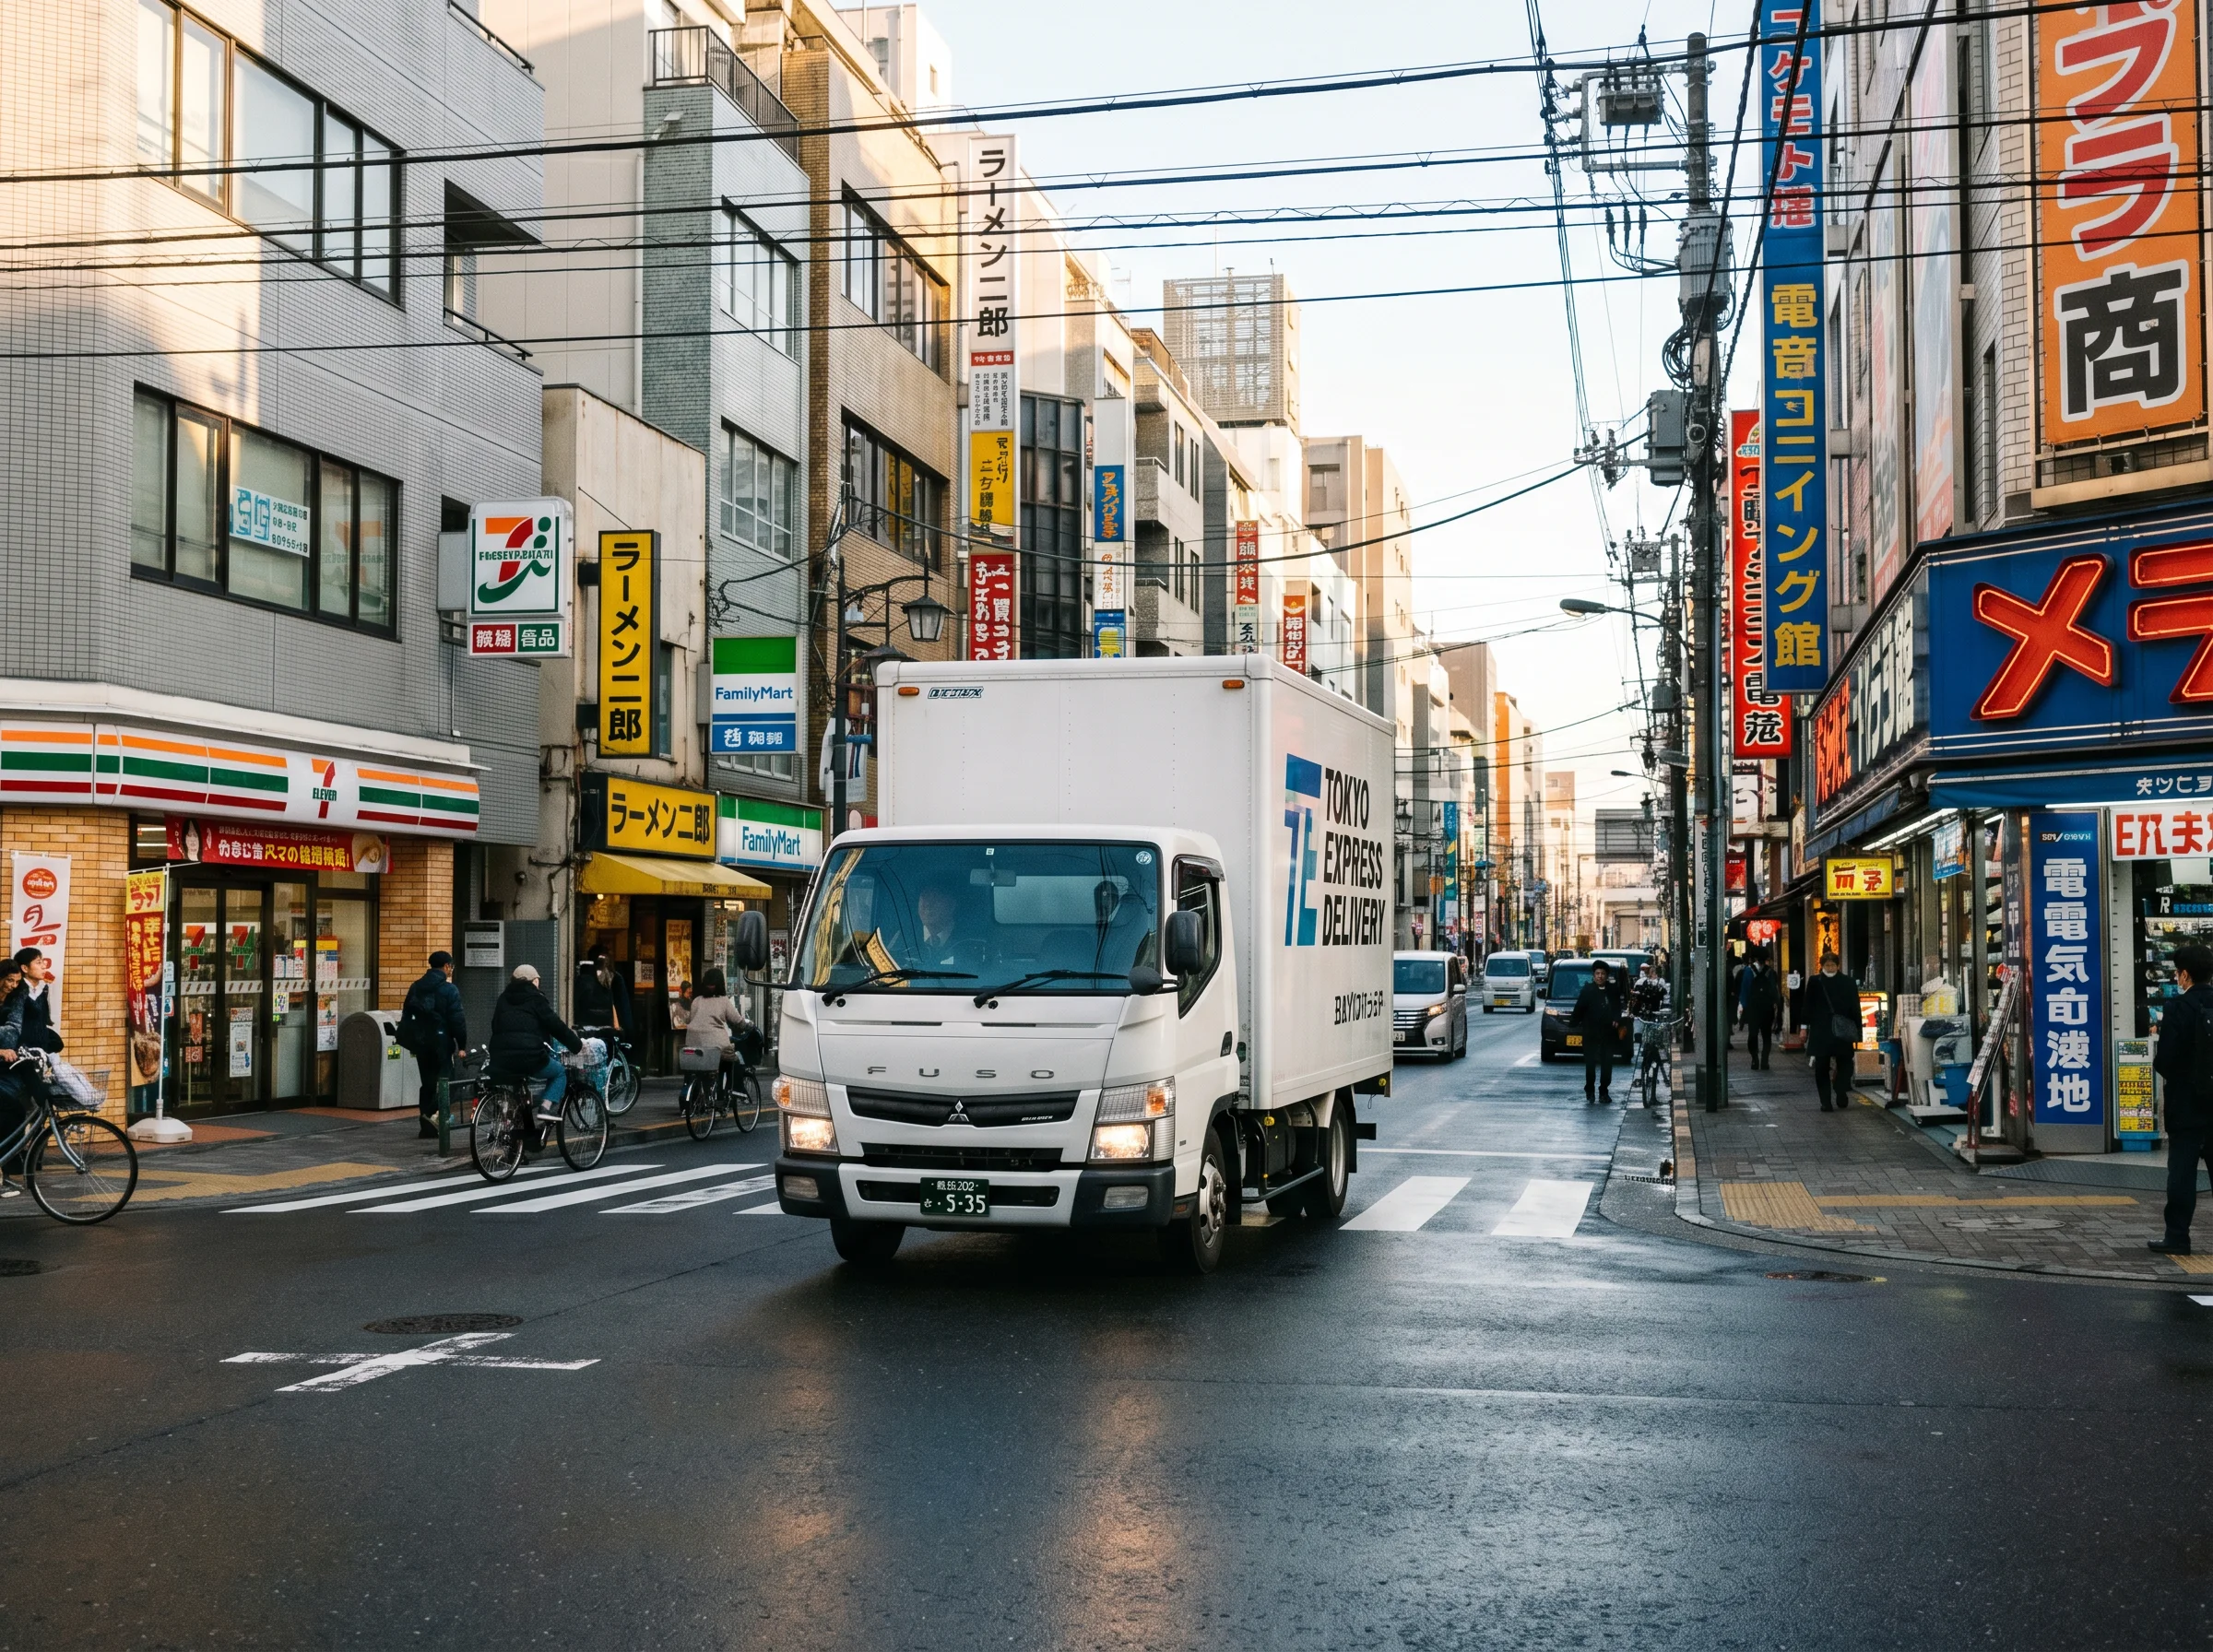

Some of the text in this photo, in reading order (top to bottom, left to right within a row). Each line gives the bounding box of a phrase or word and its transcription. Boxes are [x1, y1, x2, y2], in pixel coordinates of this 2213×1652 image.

[977, 149, 1009, 337] ラーメン二郎
[609, 542, 642, 741] ラーメン二郎
[716, 686, 793, 702] FamilyMart
[611, 793, 710, 845] ラーメン二郎
[1325, 767, 1370, 830] TOKYO
[742, 826, 800, 859] FamilyMart
[1323, 832, 1383, 890] EXPRESS
[1322, 893, 1386, 946] DELIVERY
[867, 1067, 1055, 1080] FUSO
